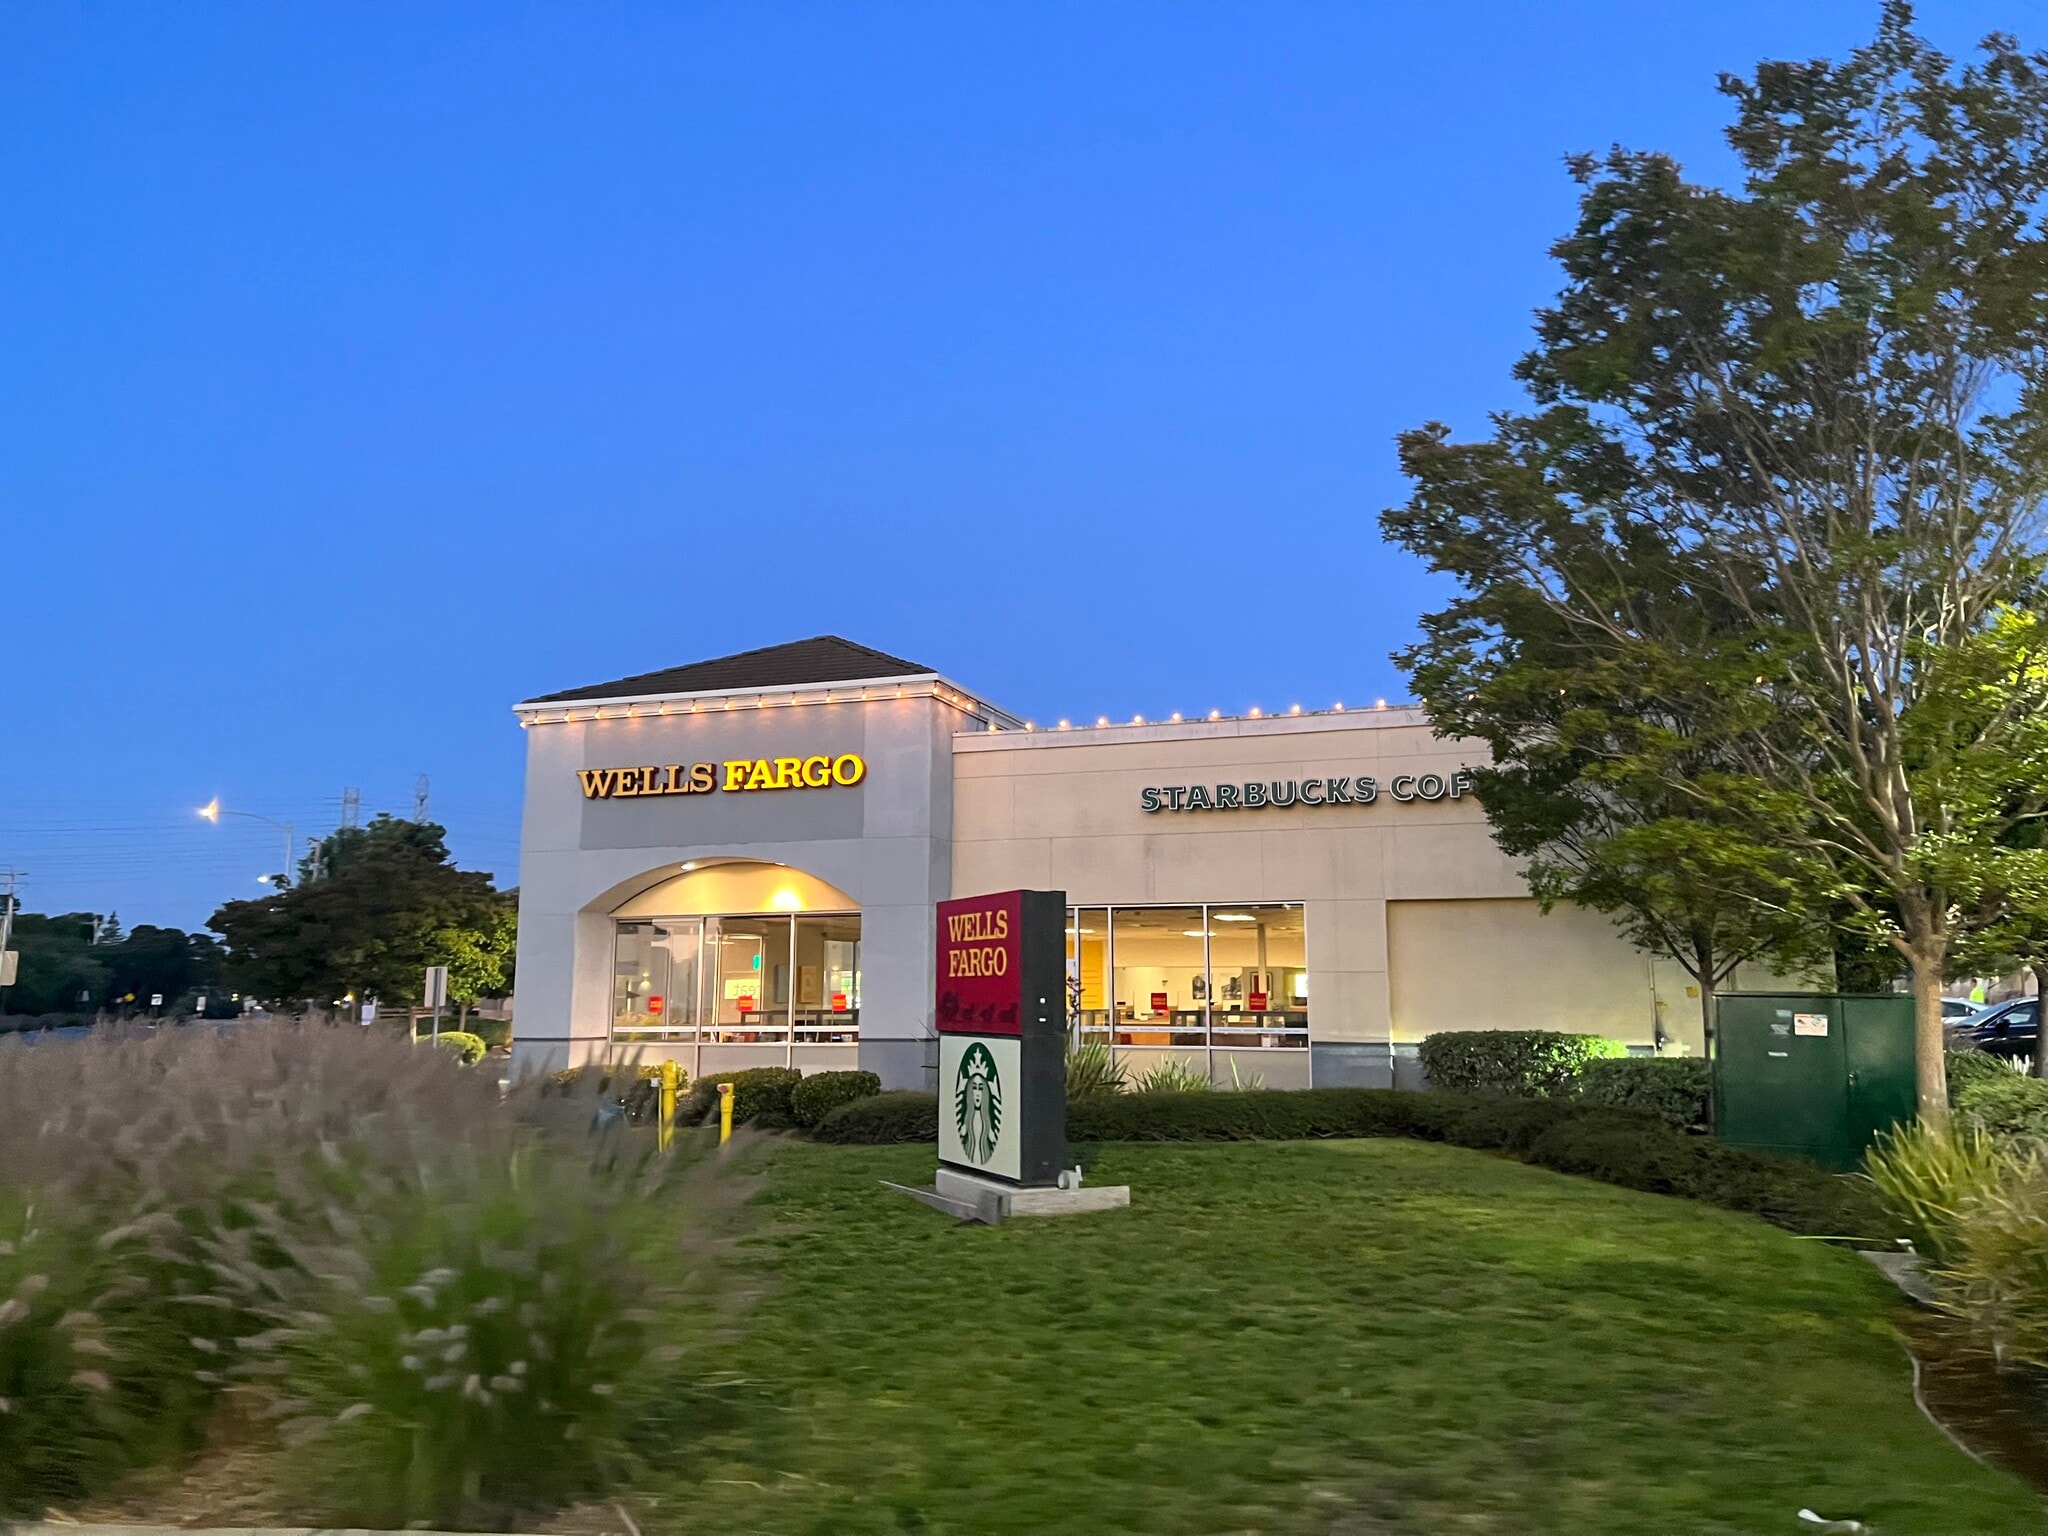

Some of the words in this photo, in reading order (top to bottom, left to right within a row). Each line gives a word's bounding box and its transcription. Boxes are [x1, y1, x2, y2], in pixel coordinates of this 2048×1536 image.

[577, 763, 716, 799] WELLS
[722, 754, 866, 791] FARGO
[1141, 776, 1378, 812] STARBUCKS
[947, 909, 1009, 942] WELLS
[948, 946, 1008, 977] FARGO
